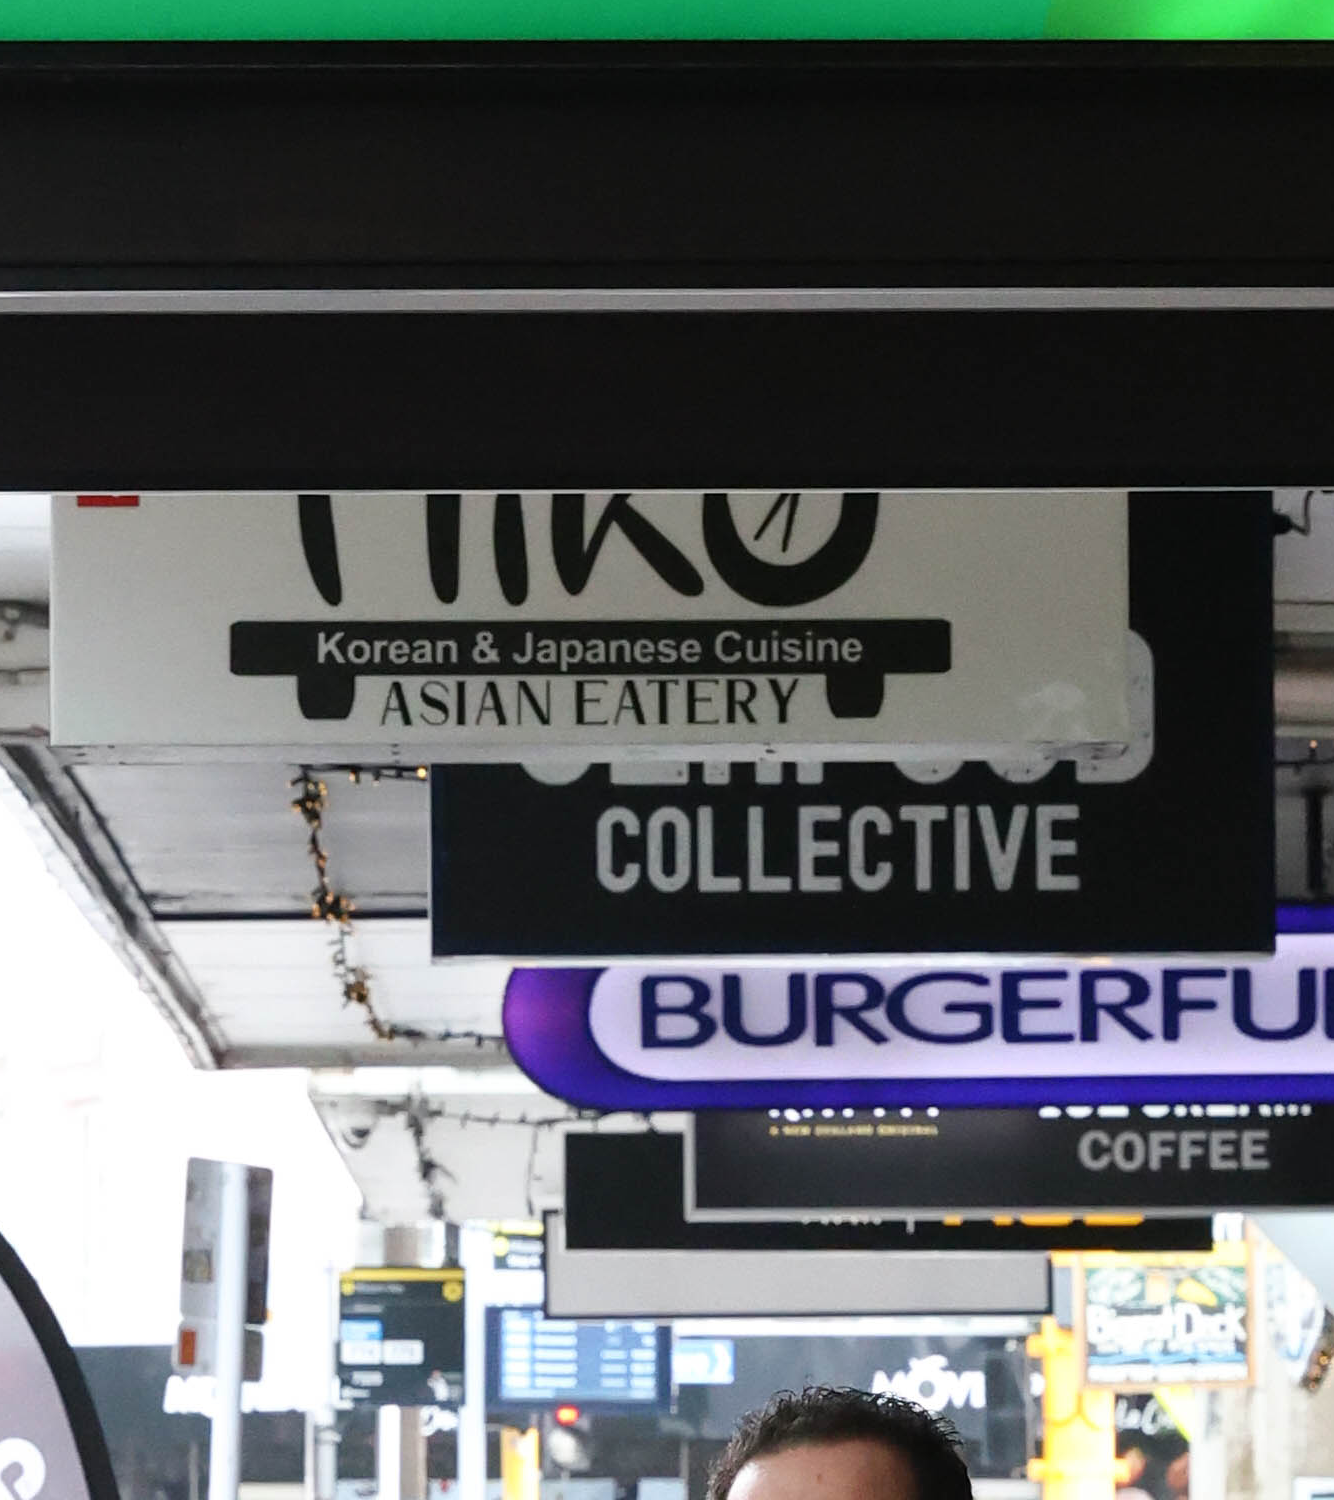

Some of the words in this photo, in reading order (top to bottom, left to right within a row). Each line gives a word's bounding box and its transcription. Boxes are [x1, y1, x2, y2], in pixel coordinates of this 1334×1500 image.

[317, 631, 459, 665] Korean
[472, 631, 500, 665] &
[512, 631, 701, 672] Japanese
[714, 629, 864, 664] Cuisine
[380, 680, 552, 726] ASIAN
[575, 678, 799, 725] EATERY
[596, 804, 1081, 893] COLLECTIVE
[1078, 1130, 1270, 1171] COFFEE
